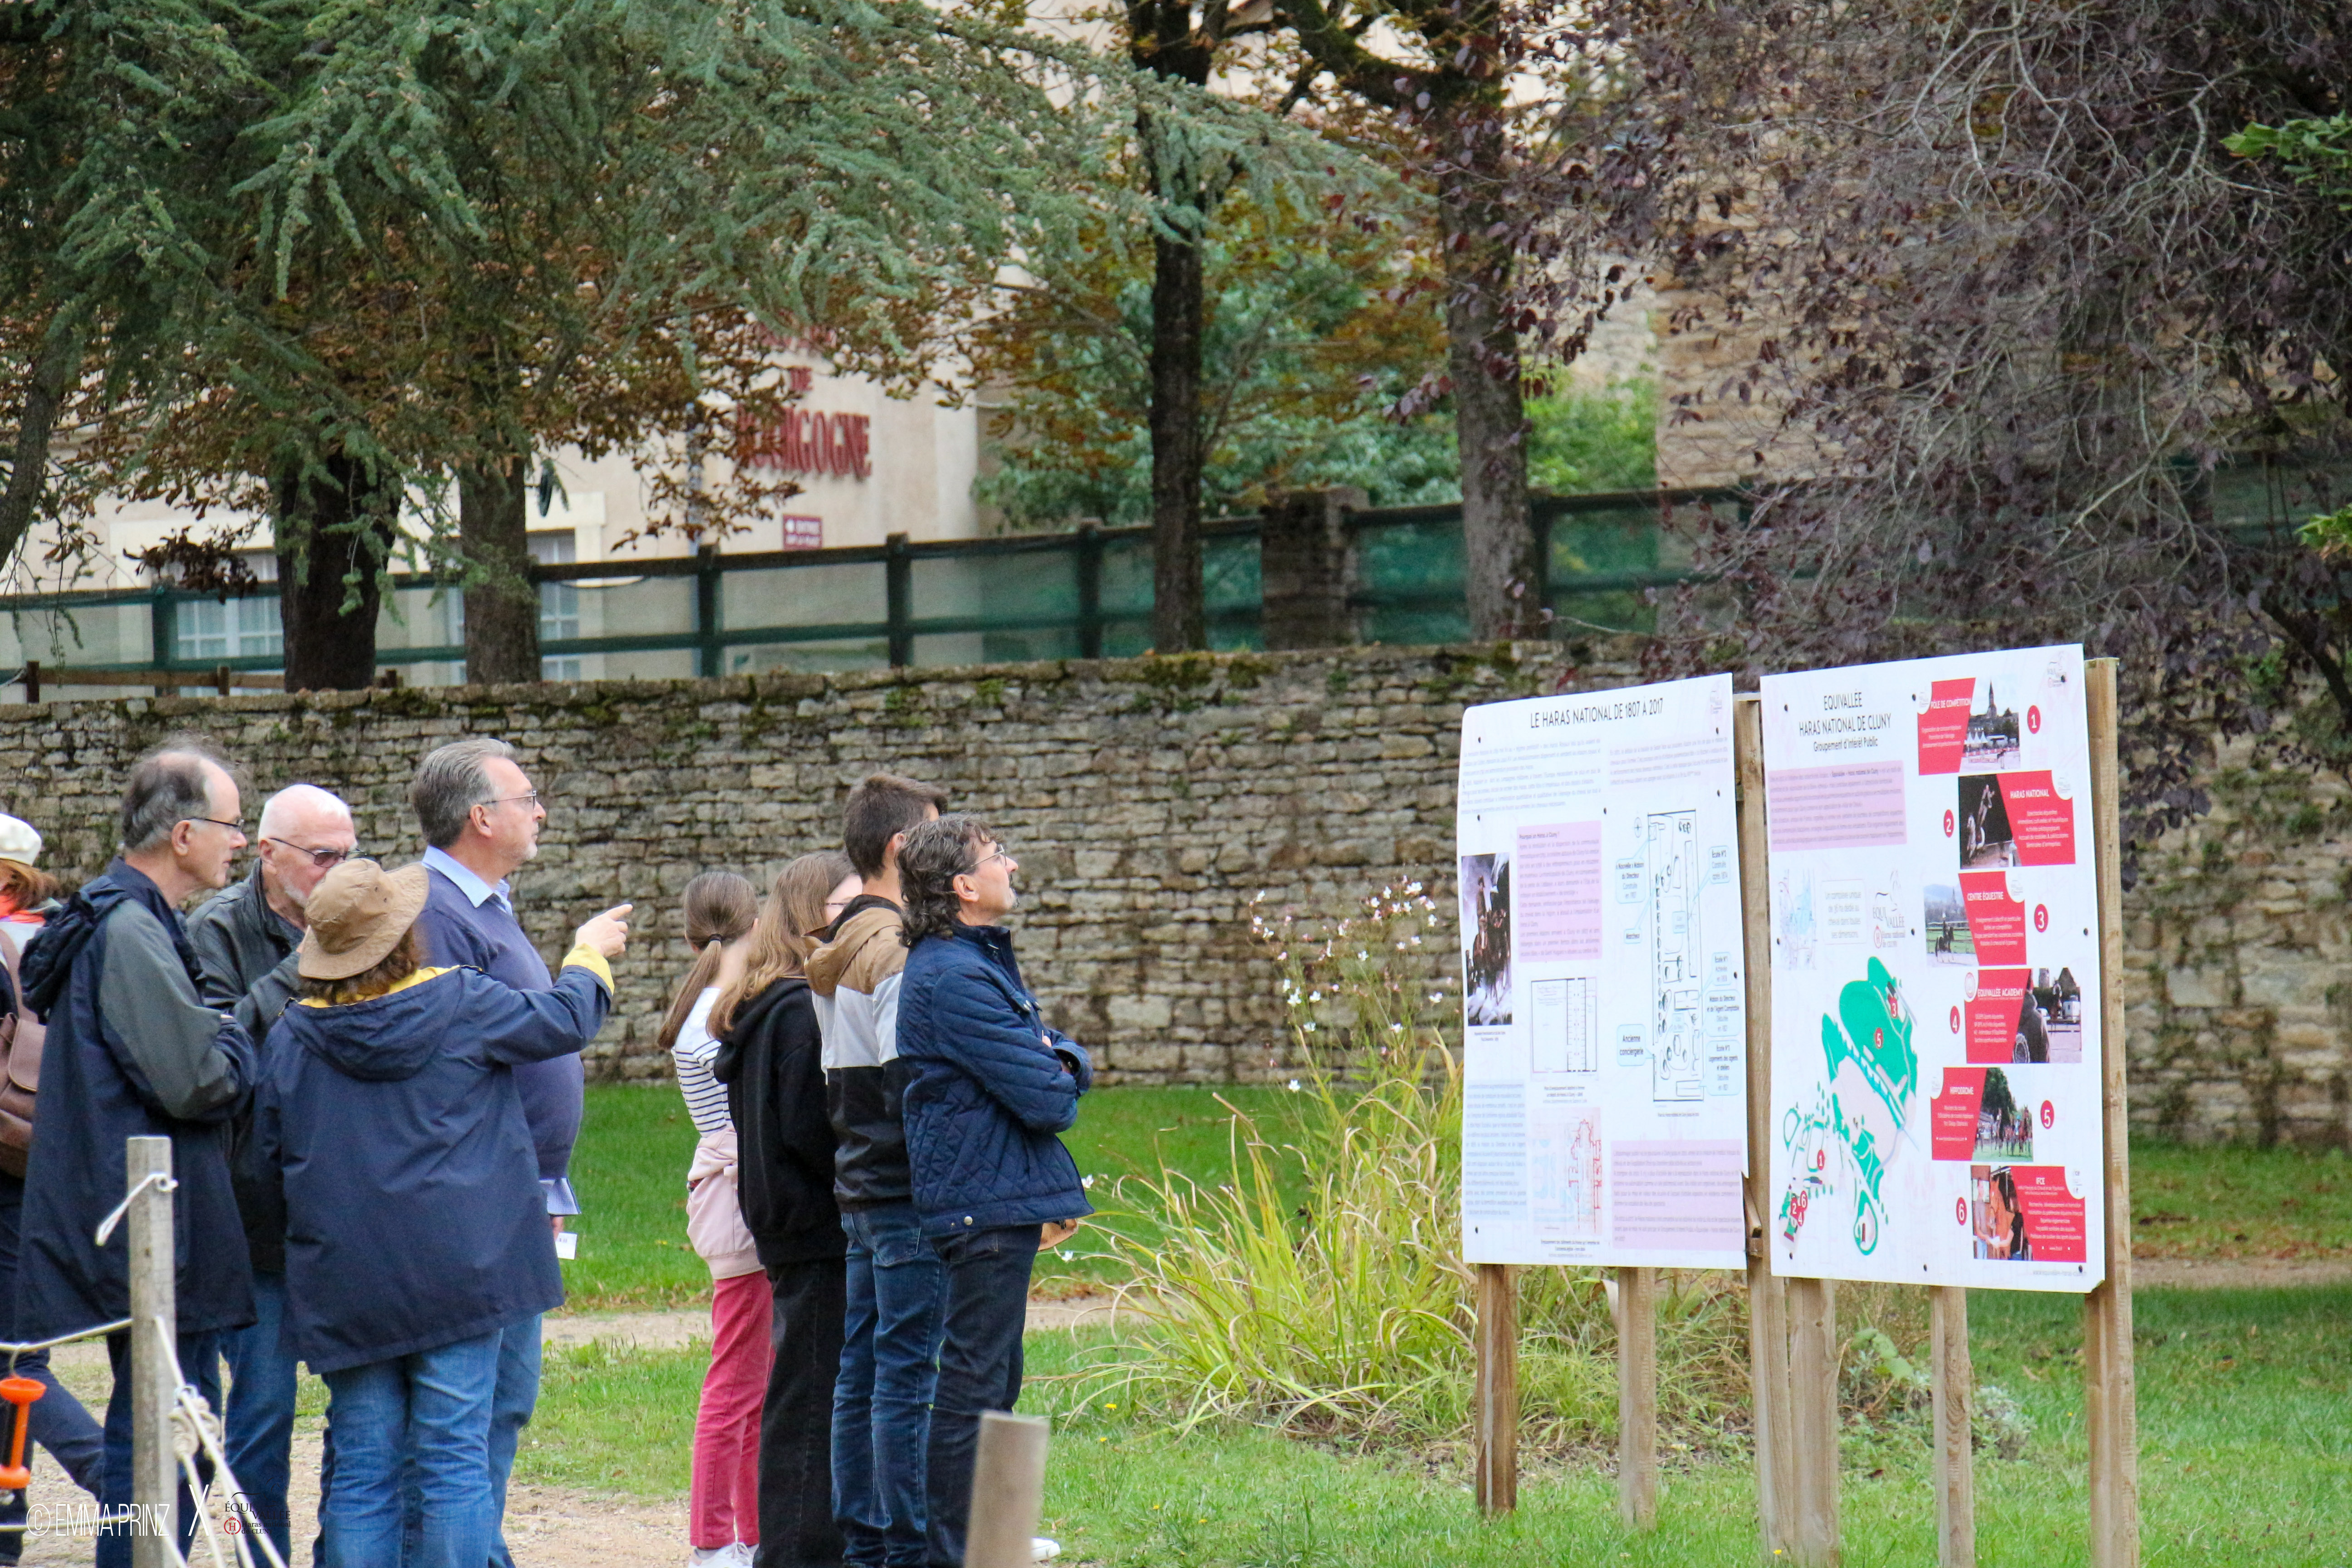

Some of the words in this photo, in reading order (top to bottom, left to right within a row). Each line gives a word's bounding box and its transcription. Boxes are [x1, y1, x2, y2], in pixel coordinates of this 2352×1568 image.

[1823, 689, 1862, 710] EQUIVALLÉE
[1940, 700, 1946, 708] DE
[1946, 698, 1971, 708] COMPÉTITION
[1530, 712, 1539, 728] LE
[1543, 709, 1570, 727] HARAS
[1573, 705, 1612, 724] NATIONAL
[1614, 703, 1623, 720] DE
[1625, 701, 1640, 718] 1807
[1642, 696, 1647, 716] À
[1649, 697, 1663, 715] 2017
[1799, 720, 1821, 736] HARAS
[1822, 717, 1856, 734] NATIONAL
[1857, 715, 1866, 731] DE
[1868, 713, 1891, 730] CLUNY
[2031, 714, 2037, 729] 1
[1813, 740, 1842, 753] Groupement
[1864, 735, 1878, 747] Public
[2010, 790, 2025, 799] HARAS
[2026, 789, 2050, 798] NATIONAL
[1945, 818, 1952, 833] 2
[1967, 892, 1982, 901] CENTRE
[1982, 891, 2004, 900] ÉQUESTRE
[1886, 914, 1905, 928] VALLÉE
[2038, 911, 2045, 929] 3
[1978, 988, 2001, 997] EQUIVALLÉE
[2002, 988, 2023, 996] ACADEMY
[1892, 1004, 1896, 1017] 3
[1952, 1015, 1957, 1032] 4
[1877, 1033, 1881, 1047] 5
[1620, 1047, 1644, 1057] conciergerie
[2043, 1109, 2051, 1127] 5
[1818, 1154, 1822, 1166] 1
[1802, 1195, 1806, 1207] 6
[1793, 1203, 1797, 1215] 2
[1958, 1205, 1965, 1220] 6
[1798, 1214, 1802, 1224] 4
